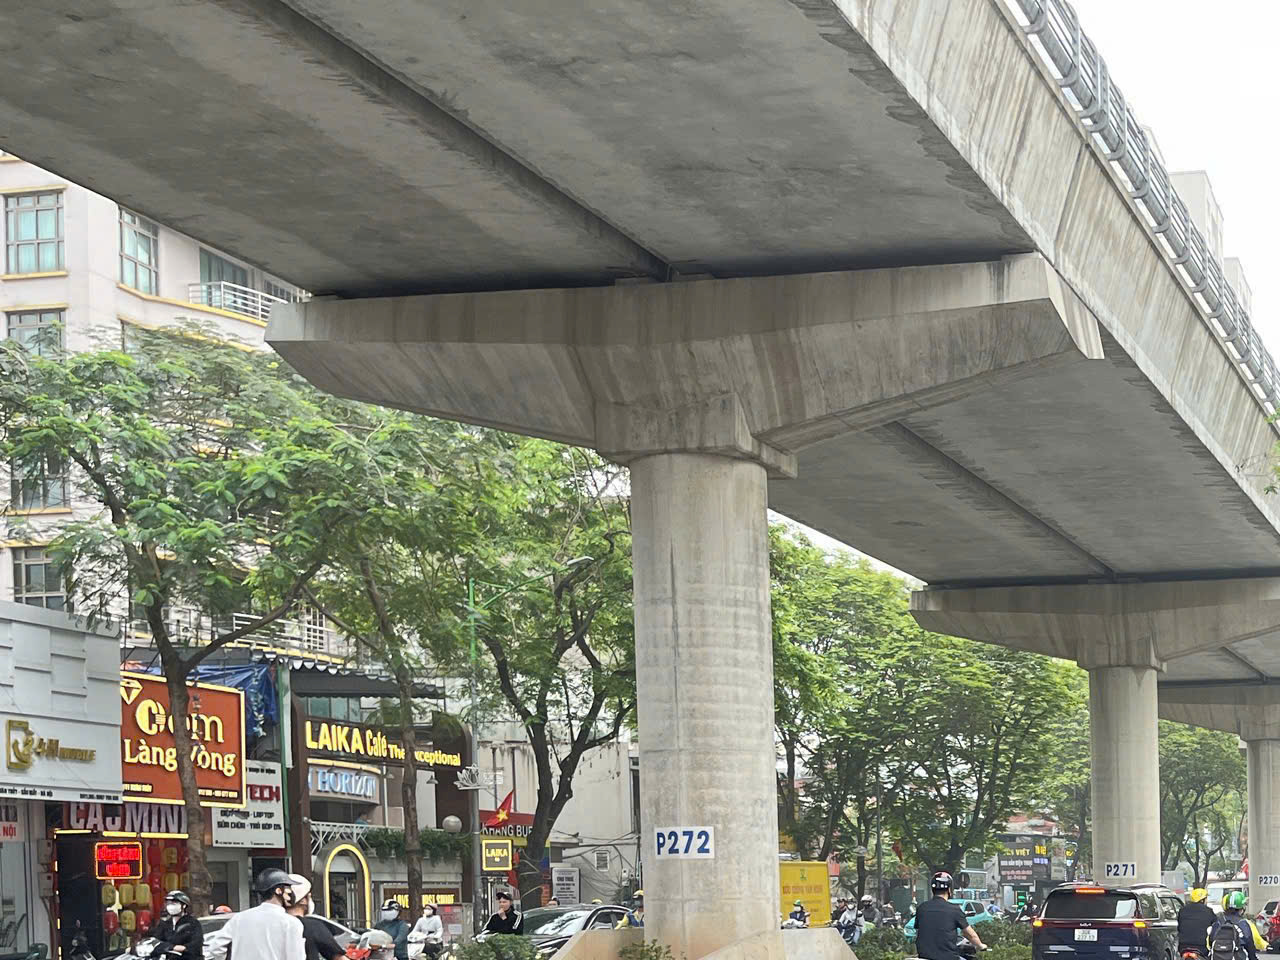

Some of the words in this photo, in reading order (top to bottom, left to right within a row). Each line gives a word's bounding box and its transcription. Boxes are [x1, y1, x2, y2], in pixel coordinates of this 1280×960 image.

[305, 720, 364, 755] LAIKA
[365, 729, 387, 758] Café
[414, 749, 461, 767] xceptional
[124, 738, 178, 772] Làng
[656, 830, 711, 855] P272
[486, 848, 508, 857] LAIKA
[1106, 863, 1136, 877] P271
[1259, 876, 1279, 885] P270
